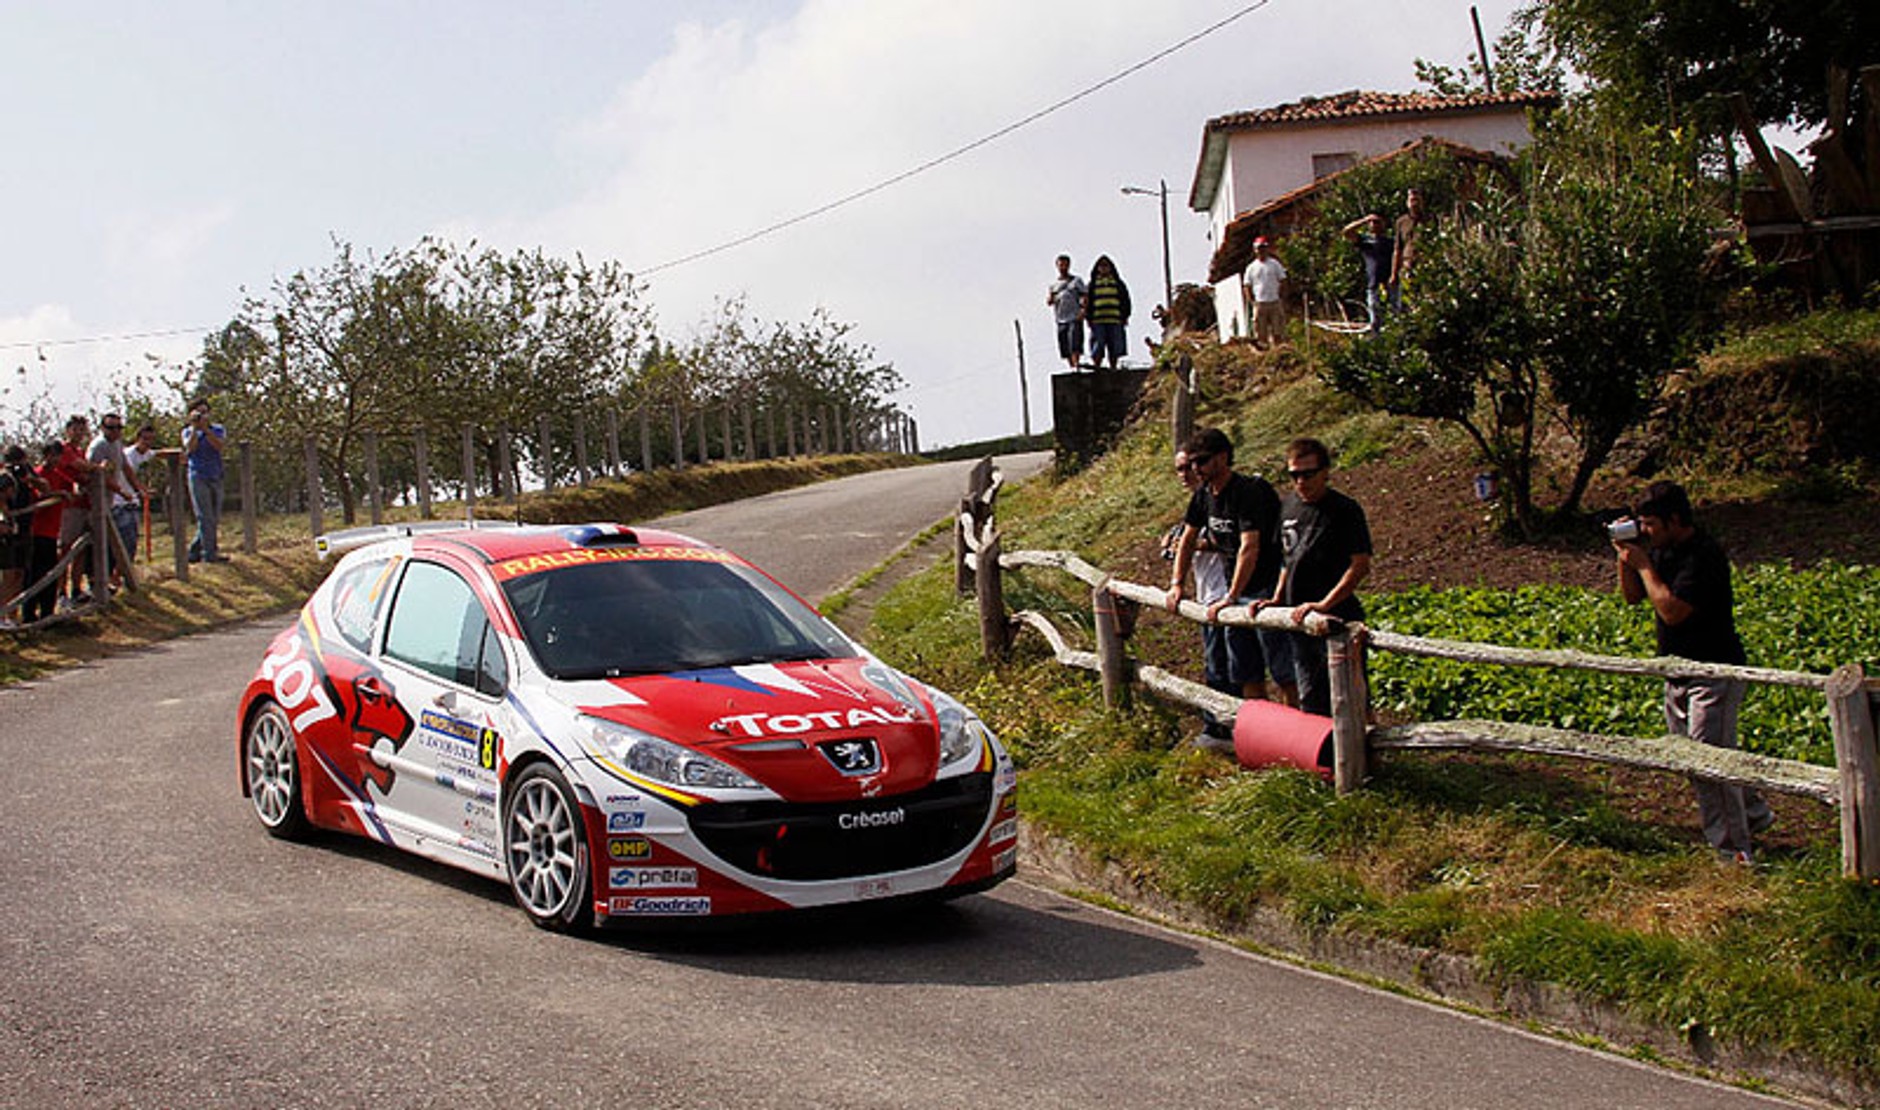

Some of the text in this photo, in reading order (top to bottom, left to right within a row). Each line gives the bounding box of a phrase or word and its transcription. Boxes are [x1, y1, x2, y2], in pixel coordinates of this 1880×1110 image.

[262, 634, 337, 734] 207
[720, 705, 914, 737] TOTAL
[482, 729, 494, 769] 8
[610, 841, 651, 856] OMP
[613, 898, 710, 910] BFGoodrich
